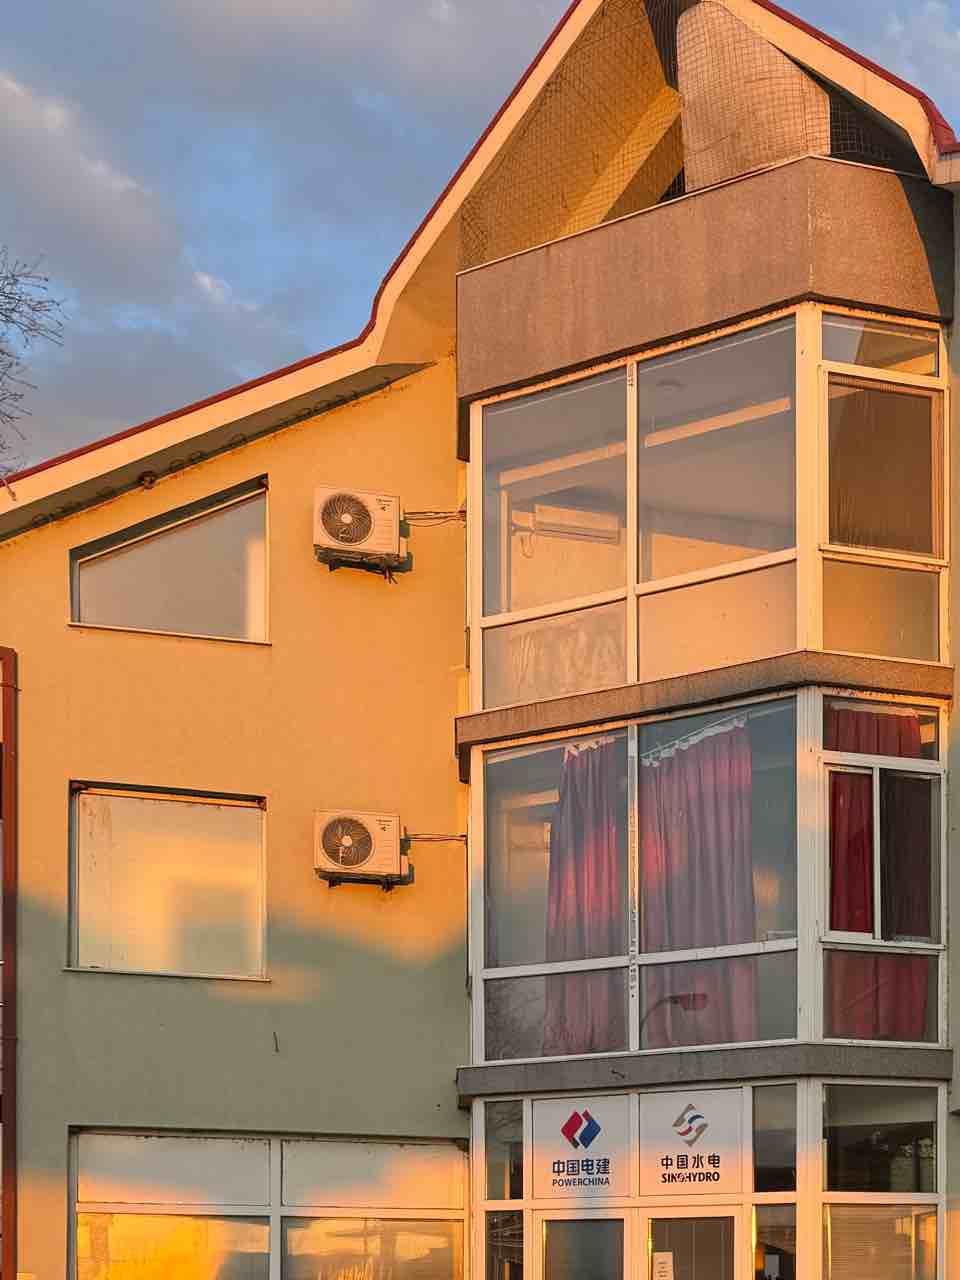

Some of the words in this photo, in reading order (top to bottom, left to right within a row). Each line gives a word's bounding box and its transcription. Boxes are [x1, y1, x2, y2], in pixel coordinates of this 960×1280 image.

[552, 1158, 610, 1176] 中国电建
[661, 1153, 720, 1170] 中国水电
[552, 1177, 610, 1188] POWERCHINA
[661, 1171, 720, 1184] SINOHYDRO
